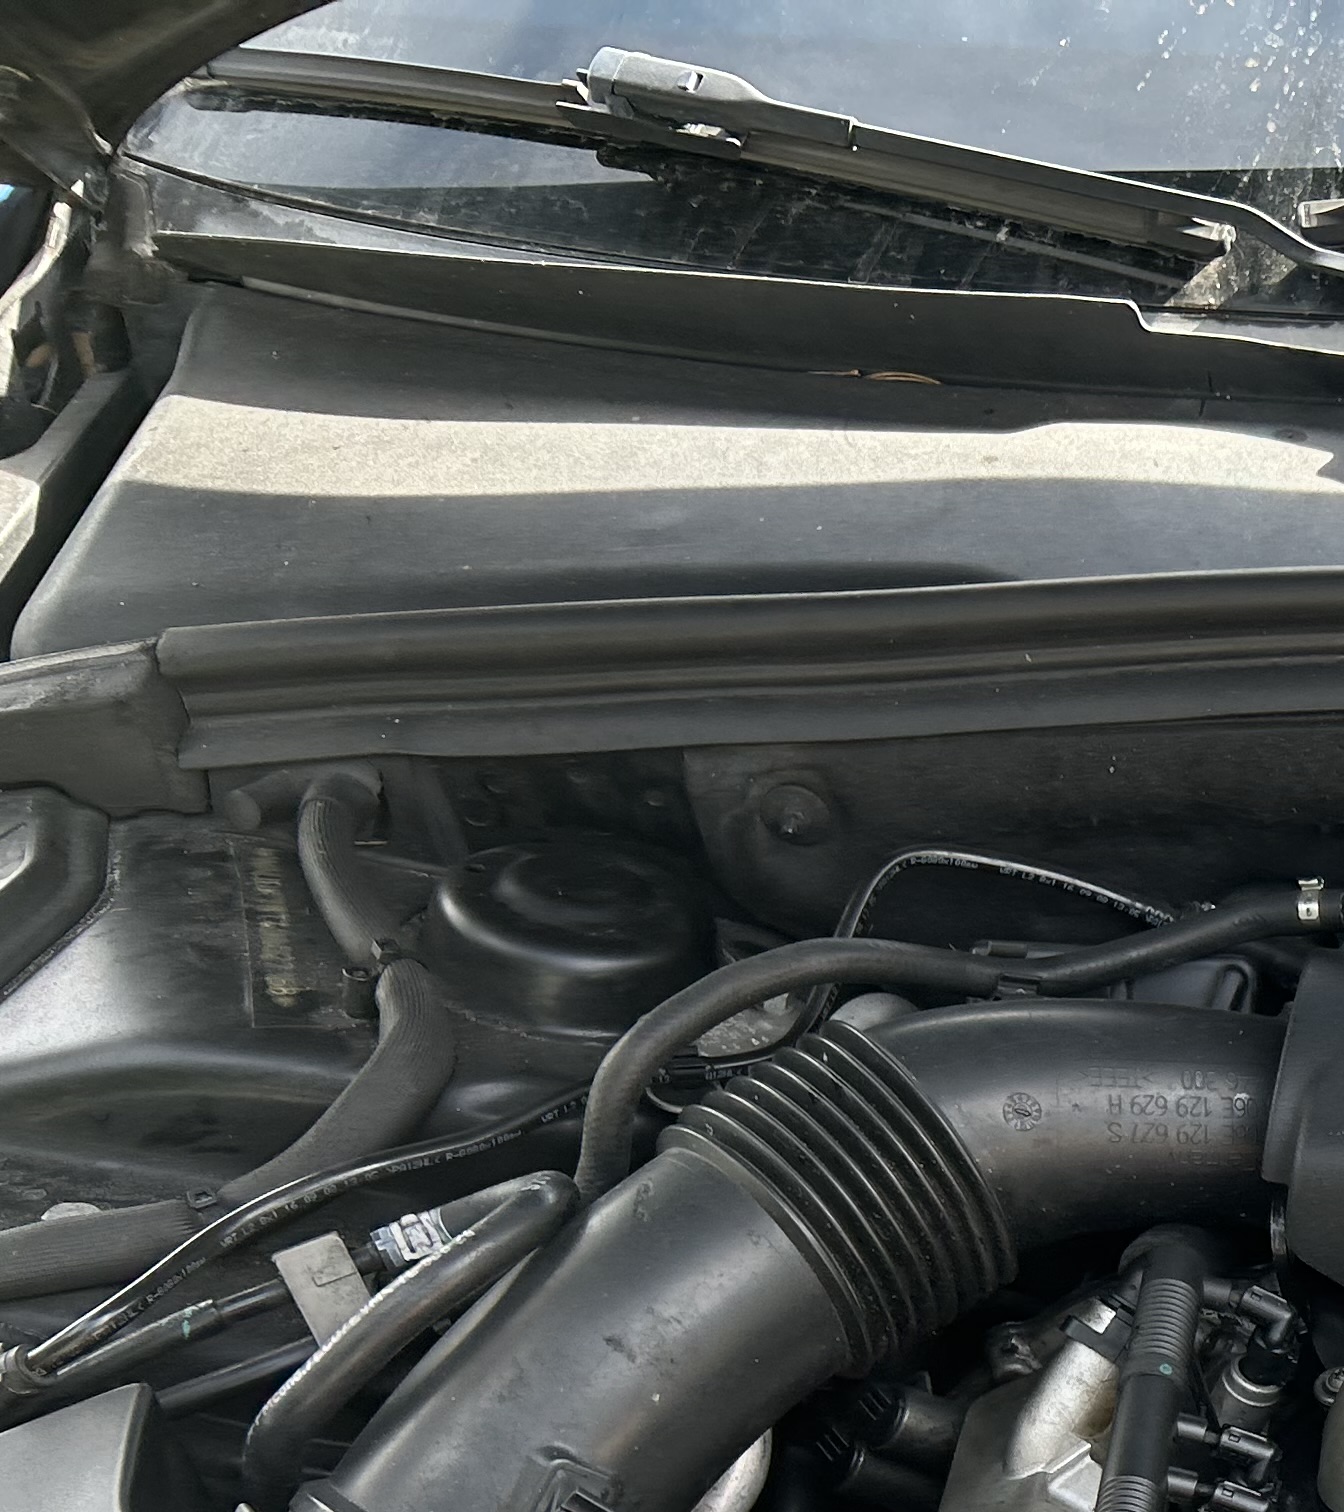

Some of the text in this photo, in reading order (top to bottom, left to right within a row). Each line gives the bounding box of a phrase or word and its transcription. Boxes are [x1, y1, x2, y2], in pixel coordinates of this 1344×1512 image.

[1107, 1093, 1122, 1116] H
[1130, 1094, 1168, 1117] 629
[1176, 1095, 1212, 1119] 129
[1107, 1121, 1122, 1144] S
[1176, 1123, 1212, 1145] 129
